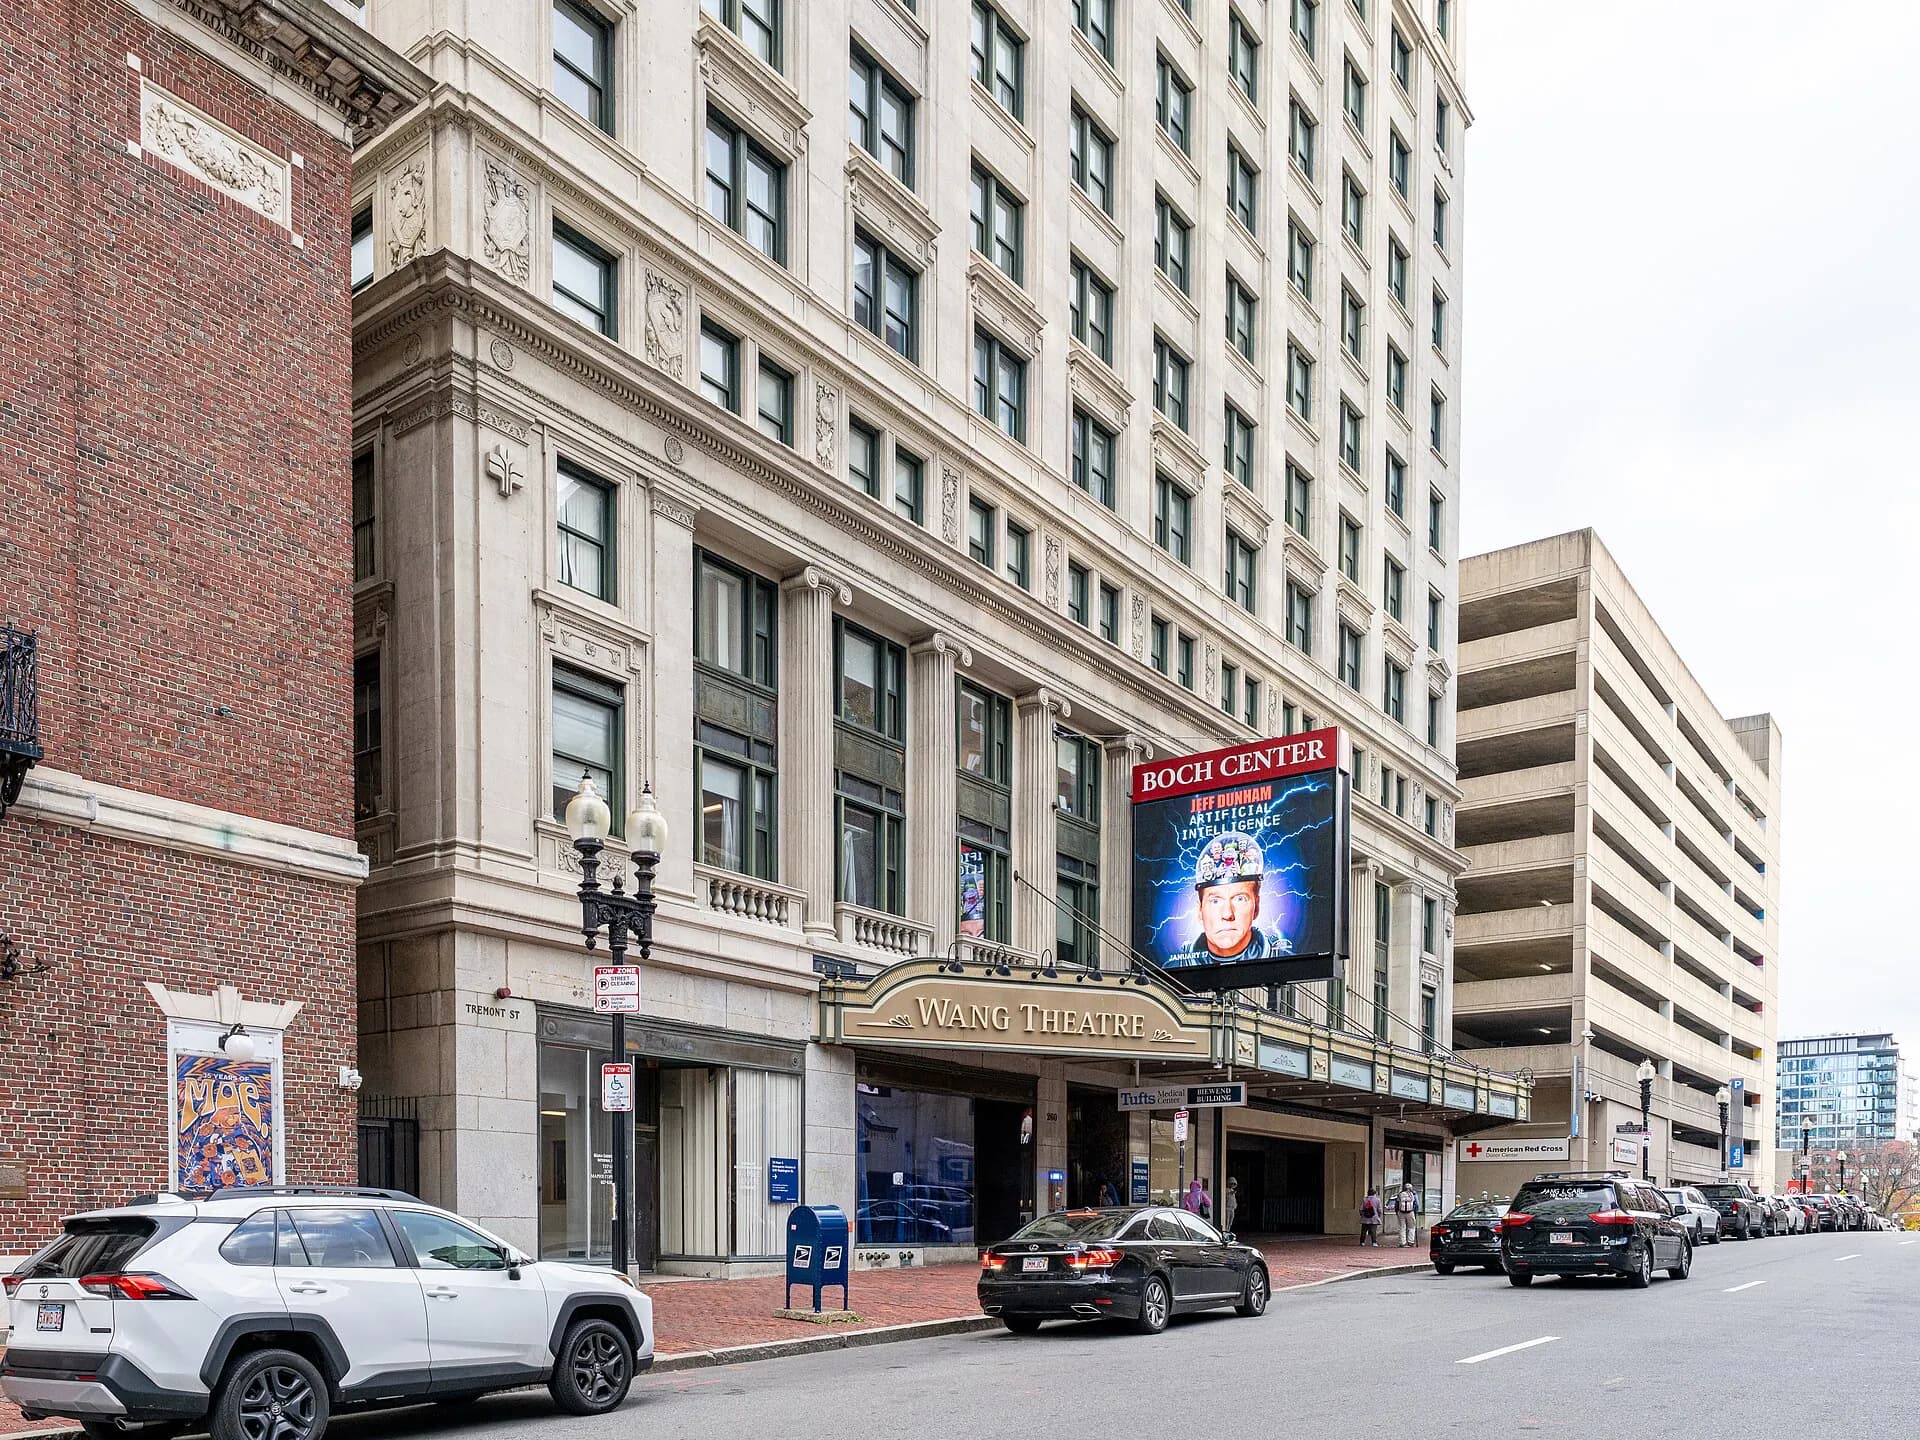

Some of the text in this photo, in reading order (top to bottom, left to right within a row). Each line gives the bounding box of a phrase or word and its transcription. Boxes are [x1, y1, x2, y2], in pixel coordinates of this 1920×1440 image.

[1141, 739, 1327, 792] BOCH CENTER
[1190, 785, 1272, 813] JEFF DUNHAM
[1189, 802, 1272, 826] ARTIFICIAL
[1182, 814, 1281, 841] INTELLIGENCE
[1169, 951, 1209, 962] JANUARY 17
[465, 1003, 520, 1020] TREMONT ST
[916, 996, 1146, 1038] WANG THEATRE
[213, 1073, 237, 1081] YEARS
[1197, 1087, 1232, 1096] BIEWEND
[1733, 1080, 1742, 1089] P
[1120, 1088, 1185, 1106] Tufts Medical
[1157, 1096, 1180, 1105] Center
[1196, 1094, 1232, 1103] BUILDING
[1600, 1235, 1609, 1246] 12
